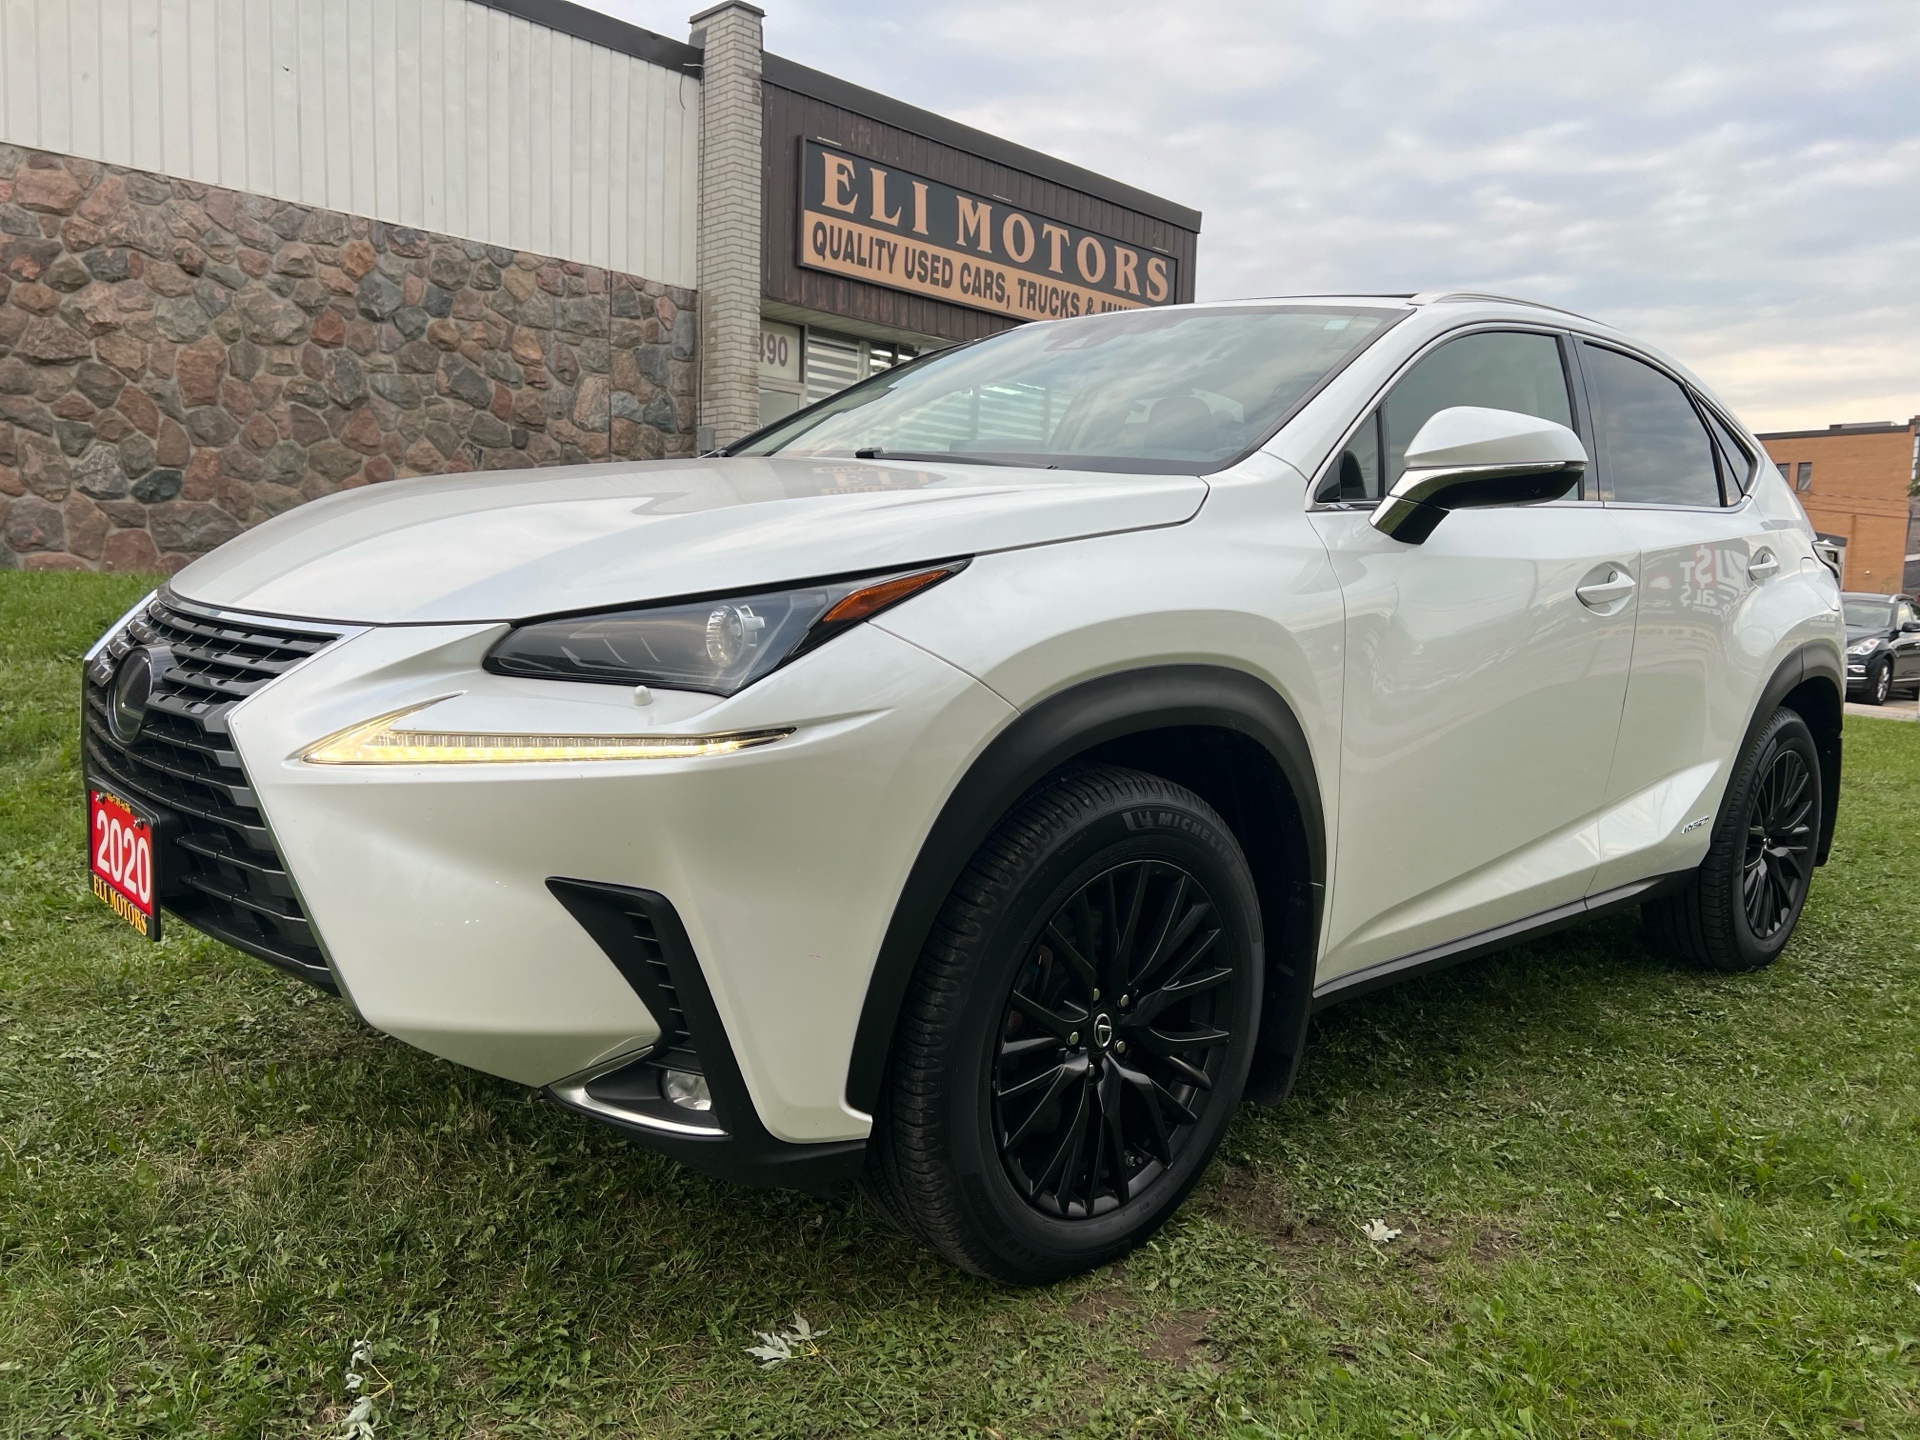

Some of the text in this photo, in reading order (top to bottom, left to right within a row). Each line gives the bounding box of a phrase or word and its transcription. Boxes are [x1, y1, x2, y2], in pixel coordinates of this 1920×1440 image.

[812, 221, 1107, 319] QUALITY USED CARS, TRUCKS &
[821, 151, 1169, 302] ELI MOTORS
[96, 809, 151, 905] 2020
[1157, 811, 1237, 867] MICHELIN
[92, 875, 148, 936] ELI MOTORS
